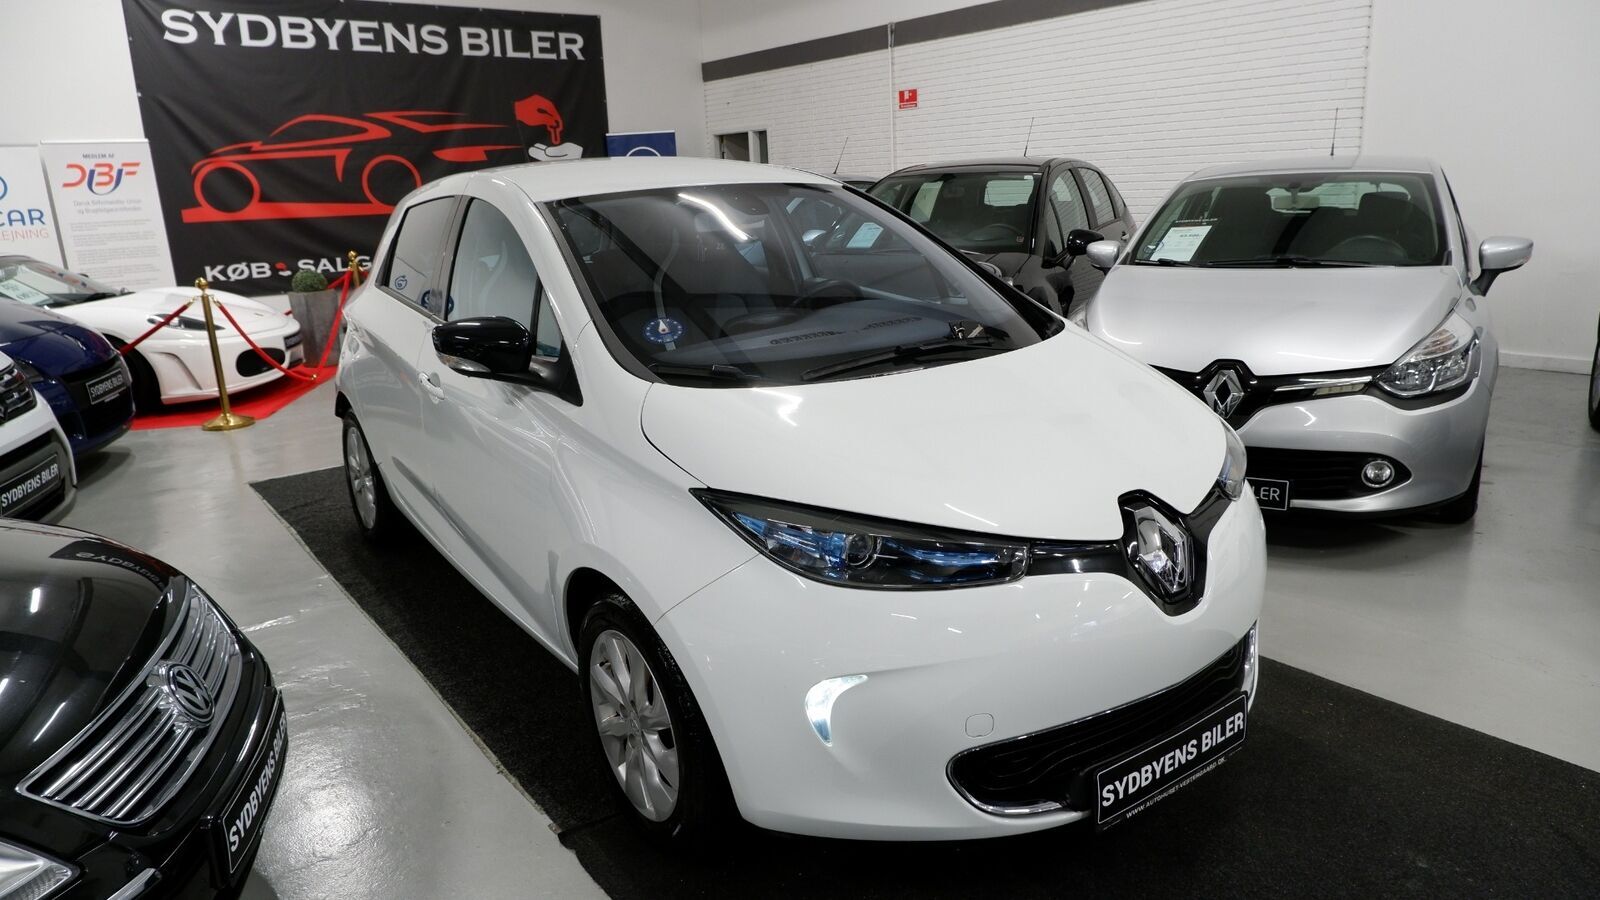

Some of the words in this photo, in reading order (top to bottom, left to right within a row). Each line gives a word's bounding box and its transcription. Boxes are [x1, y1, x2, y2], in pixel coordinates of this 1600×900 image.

[161, 9, 449, 56] SYDBYENS
[459, 26, 586, 61] BILER
[0, 229, 49, 242] EJNING
[204, 261, 272, 282] KØB
[297, 255, 372, 274] SALG
[1, 474, 41, 507] SYDBYENS
[41, 463, 58, 484] BILER
[1101, 739, 1198, 807] SYDBYENS
[1201, 711, 1244, 753] BILER
[229, 751, 276, 852] SYDBYENS
